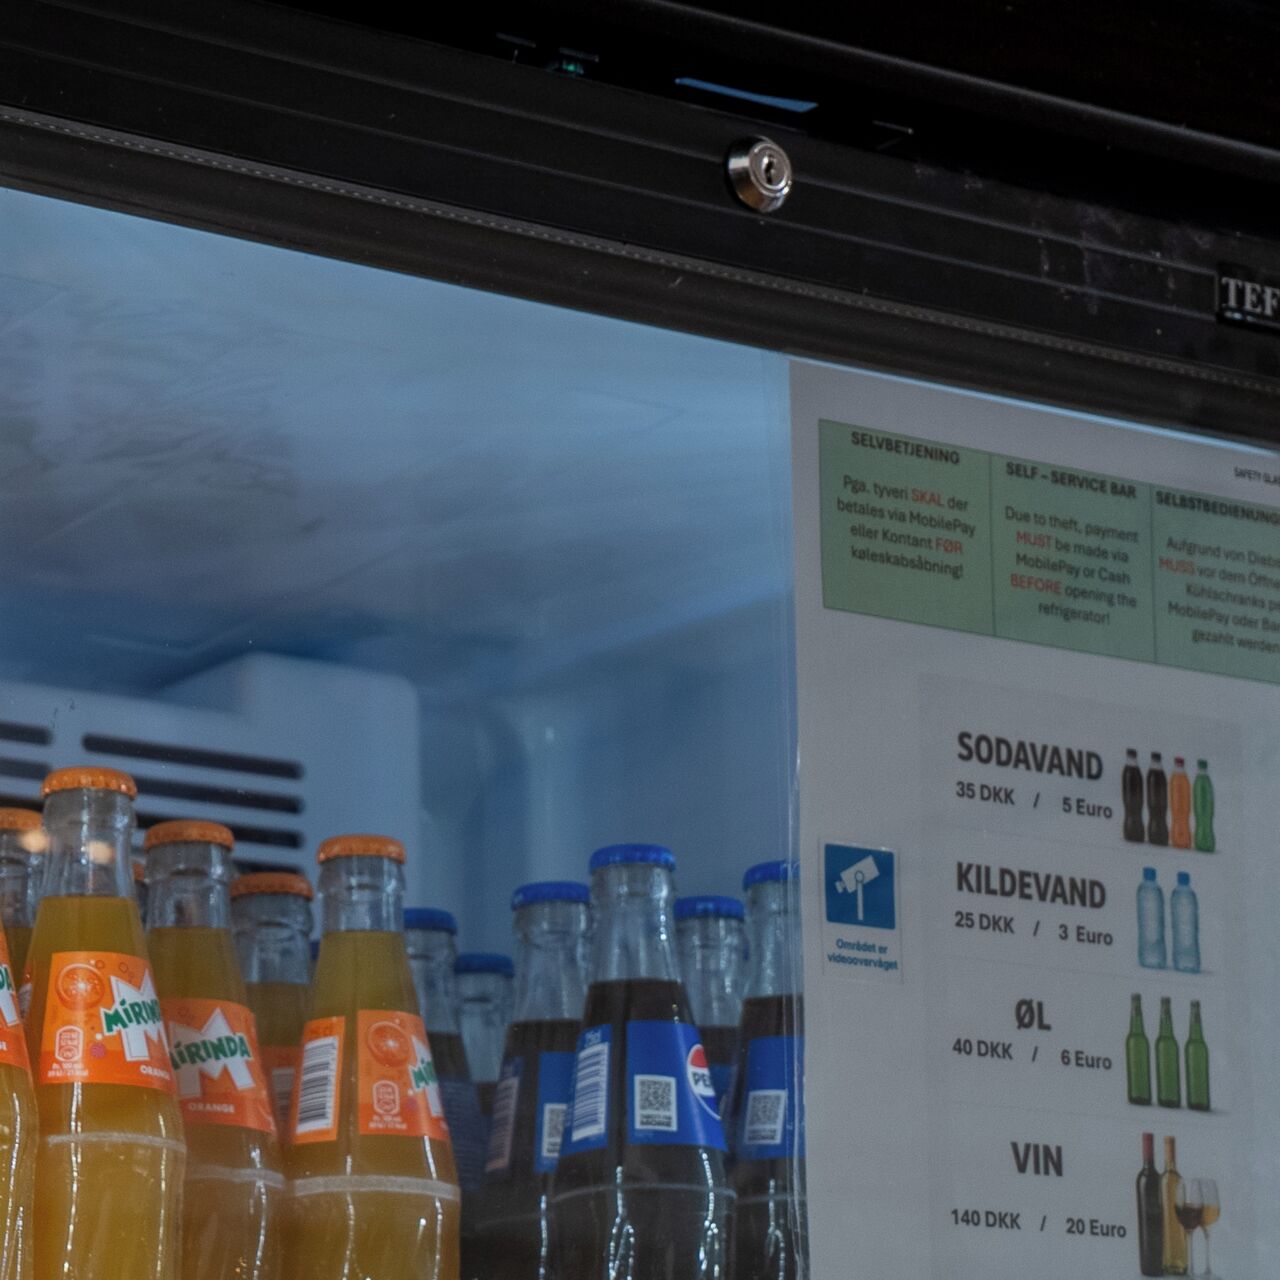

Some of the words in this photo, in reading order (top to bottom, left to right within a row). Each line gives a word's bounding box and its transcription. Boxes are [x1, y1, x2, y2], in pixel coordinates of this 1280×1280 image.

[851, 431, 960, 465] SELVBETJENING
[843, 475, 869, 494] Pga.
[873, 482, 908, 500] tyveri
[912, 488, 944, 507] SKAL
[947, 496, 968, 511] der
[1006, 461, 1038, 480] SELF
[1051, 470, 1107, 494] SERVICE
[1111, 481, 1136, 499] BAR
[837, 498, 884, 519] betales
[887, 508, 906, 523] via
[909, 511, 976, 538] MobilePay
[1005, 505, 1030, 522] Due
[1034, 512, 1046, 526] to
[1085, 524, 1139, 543] payment
[850, 523, 879, 540] eller
[882, 529, 932, 550] Kontant
[936, 537, 963, 555] FØR
[1016, 531, 1051, 549] MUST
[1055, 538, 1070, 552] be
[1074, 543, 1108, 560] made
[1112, 550, 1129, 563] via
[1016, 553, 1080, 578] MobilePay
[1083, 566, 1095, 578] or
[1098, 567, 1131, 585] Cash
[1010, 573, 1061, 595] BEFORE
[1065, 585, 1114, 607] opening
[1118, 593, 1137, 608] the
[957, 730, 1104, 781] SODAVAND
[956, 781, 975, 799] 35
[980, 784, 1015, 806] DKK
[1033, 792, 1040, 808] /
[1062, 796, 1072, 813] 5
[1076, 798, 1113, 819] Euro
[956, 861, 1106, 910] KILDEVAND
[955, 911, 975, 929] 25
[979, 913, 1014, 934] DKK
[1033, 920, 1040, 937] /
[1058, 924, 1068, 941] 3
[1076, 926, 1113, 946] Euro
[1015, 998, 1052, 1031] ØL
[952, 1037, 972, 1056] 40
[977, 1039, 1013, 1060] DKK
[1032, 1045, 1039, 1062] /
[1061, 1049, 1071, 1066] 6
[1075, 1050, 1112, 1070] Euro
[188, 1102, 235, 1114] ORANGE
[1010, 1141, 1063, 1177] VIN
[951, 1208, 980, 1227] 140
[985, 1210, 1021, 1230] DKK
[1040, 1215, 1046, 1232] /
[1066, 1217, 1085, 1235] 20
[1089, 1219, 1127, 1238] Euro
